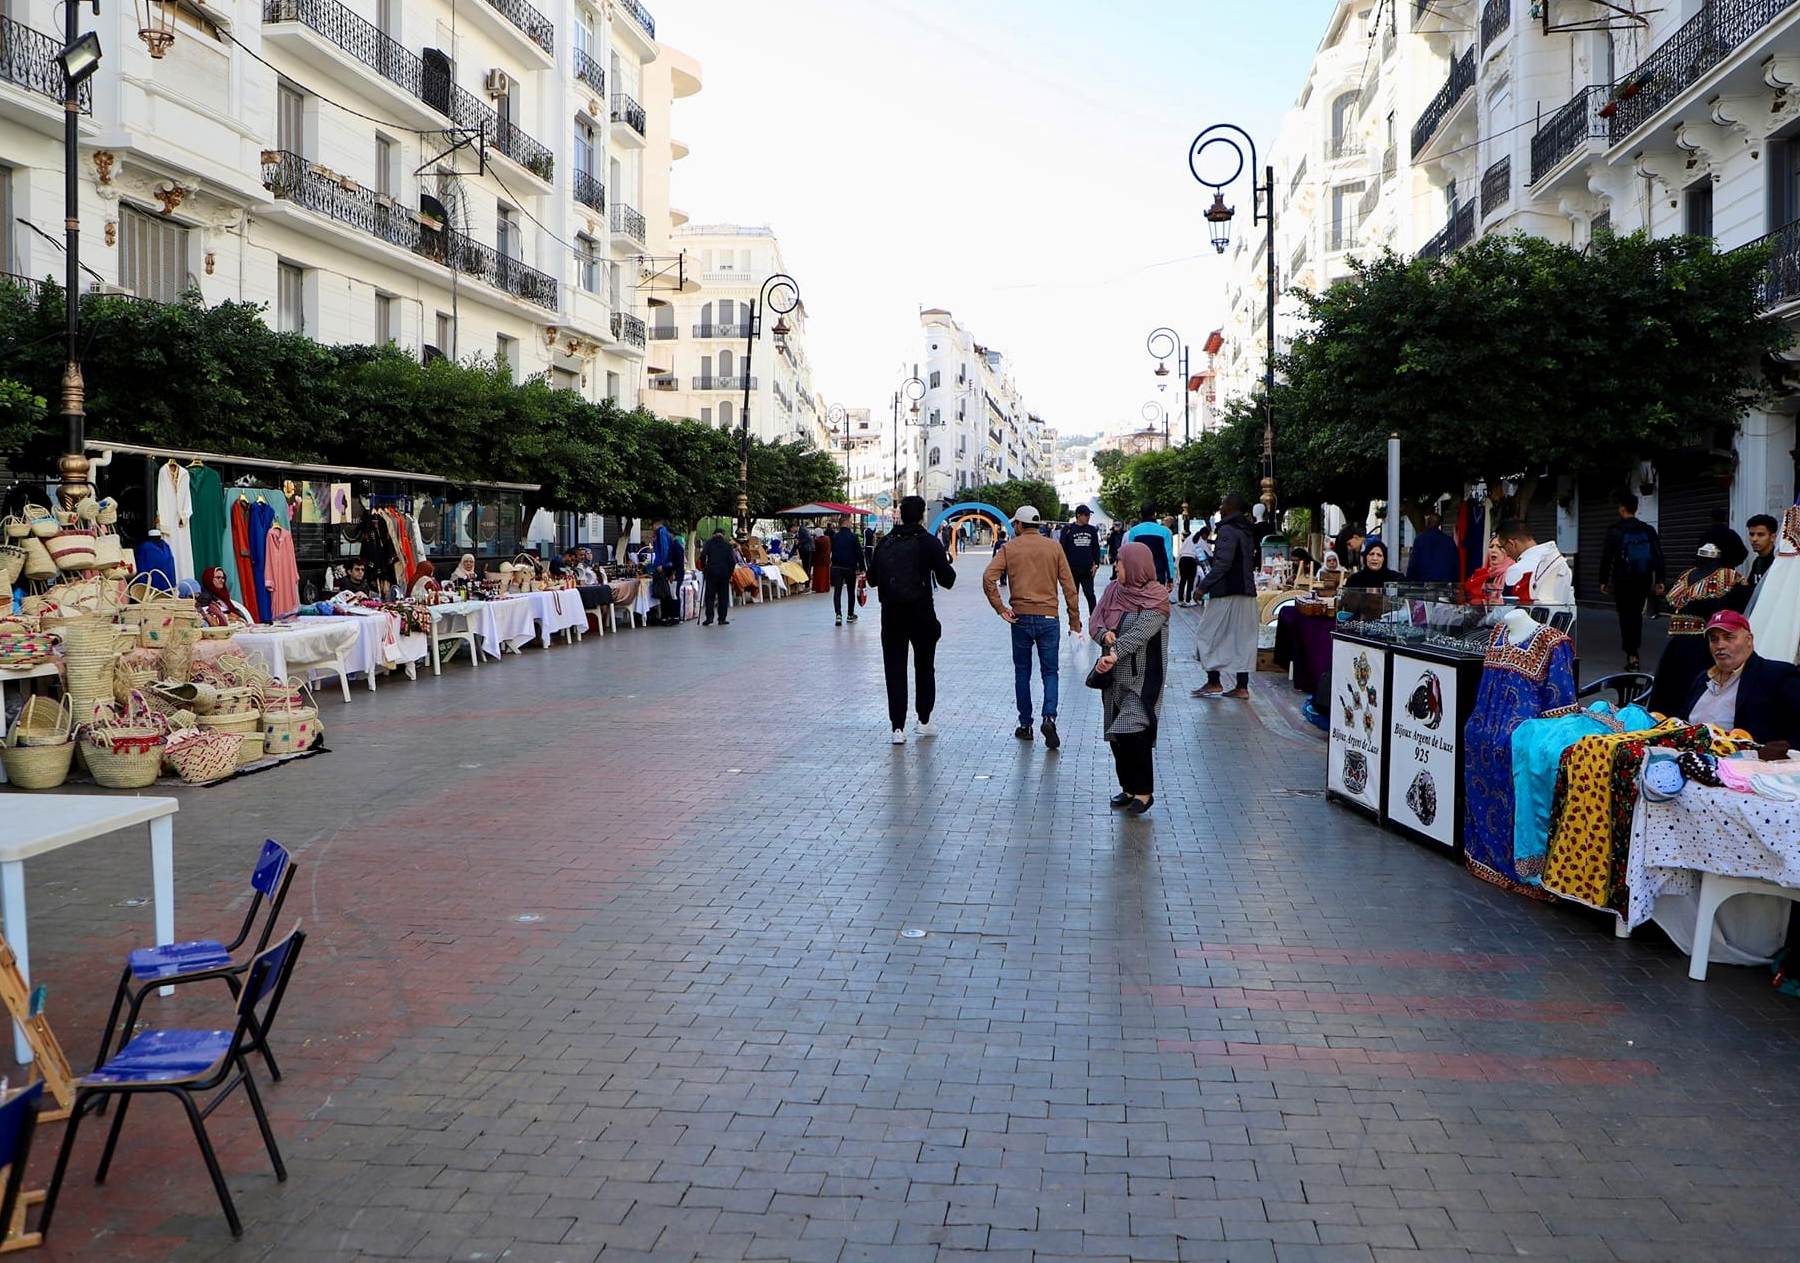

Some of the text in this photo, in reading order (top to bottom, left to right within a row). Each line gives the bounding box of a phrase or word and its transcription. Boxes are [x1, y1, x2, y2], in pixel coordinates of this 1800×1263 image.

[1394, 723, 1454, 753] Bijoux Argent de Luxe
[1415, 746, 1430, 764] 925
